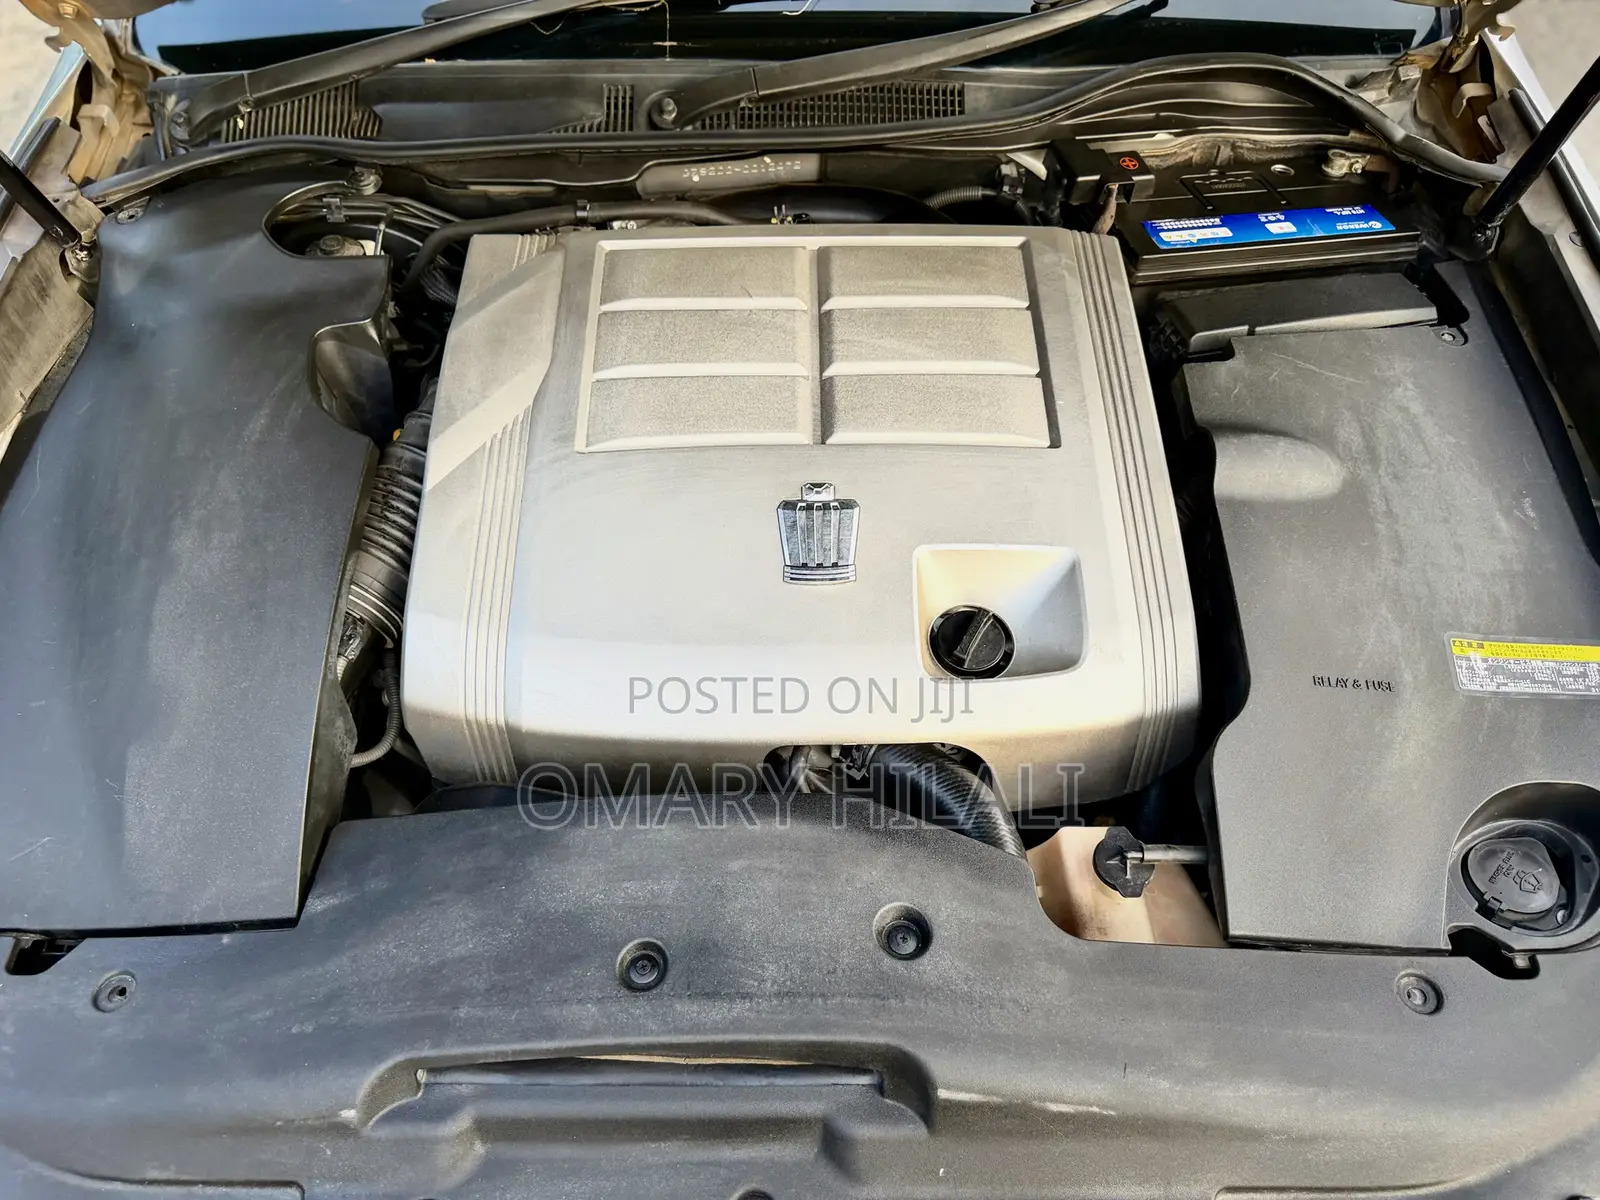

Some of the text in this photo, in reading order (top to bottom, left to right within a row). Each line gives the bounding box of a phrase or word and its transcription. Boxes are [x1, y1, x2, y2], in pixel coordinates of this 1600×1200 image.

[1312, 674, 1396, 693] RELAY & FUSE
